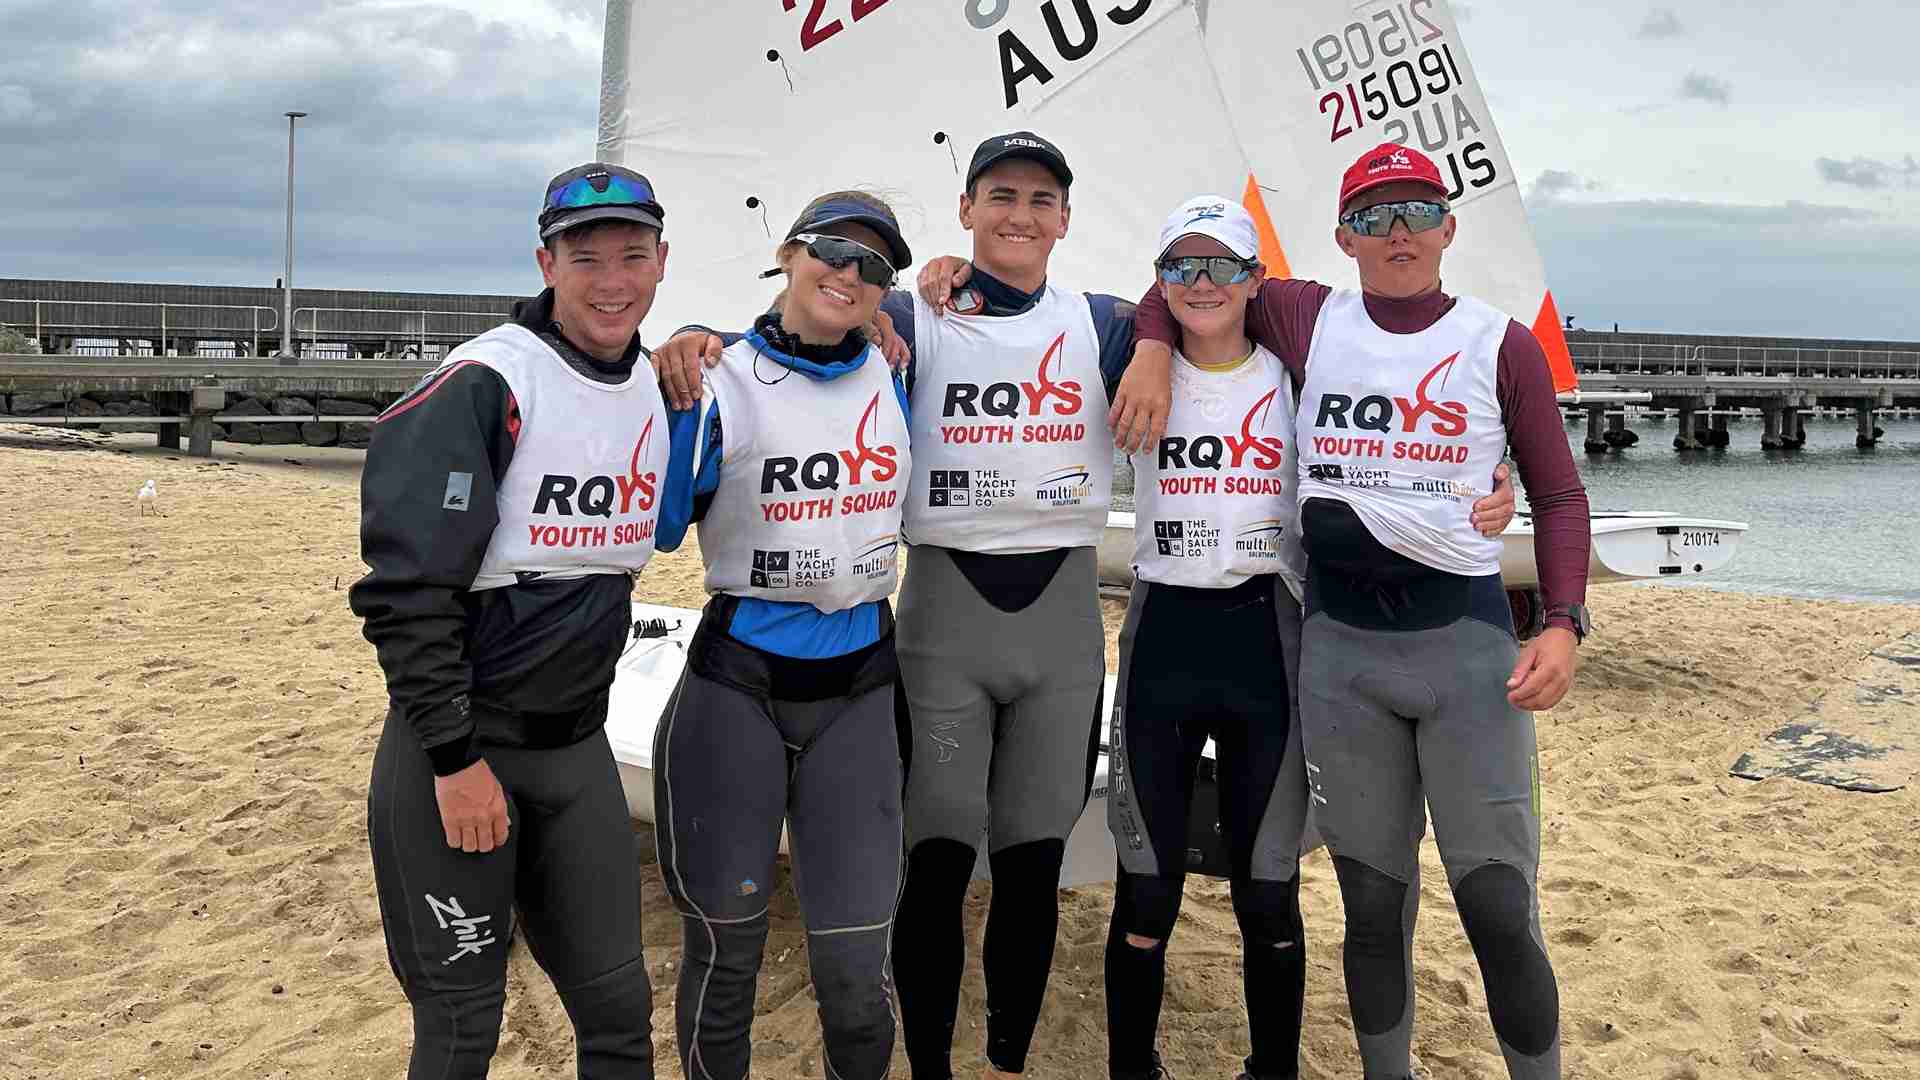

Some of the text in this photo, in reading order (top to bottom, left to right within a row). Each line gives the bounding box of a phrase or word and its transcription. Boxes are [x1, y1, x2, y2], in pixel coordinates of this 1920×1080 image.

[1319, 43, 1462, 143] 215091
[942, 381, 1083, 419] RQYS
[1314, 393, 1469, 437] RQYS
[941, 424, 1085, 444] YOUTH SQUAD
[1158, 435, 1284, 471] RQYS
[1312, 436, 1469, 464] YOUTH SQUAD
[760, 445, 897, 494] RQYS
[975, 470, 1000, 479] THE
[1348, 470, 1391, 481] YACHT
[975, 479, 1017, 488] YACHT
[1159, 477, 1282, 495] YOUTH SQUAD
[531, 472, 656, 519] RQYS
[975, 489, 1015, 498] SALES
[760, 490, 897, 522] YOUTH SQUAD
[1187, 520, 1207, 528] THE
[528, 518, 655, 548] YOUTH SQUAD
[1187, 528, 1221, 538] YACHT
[1682, 532, 1720, 546] 210174
[1187, 538, 1219, 547] SALES
[795, 550, 821, 559] THE
[795, 558, 836, 570] YACHT
[795, 569, 835, 580] SALES
